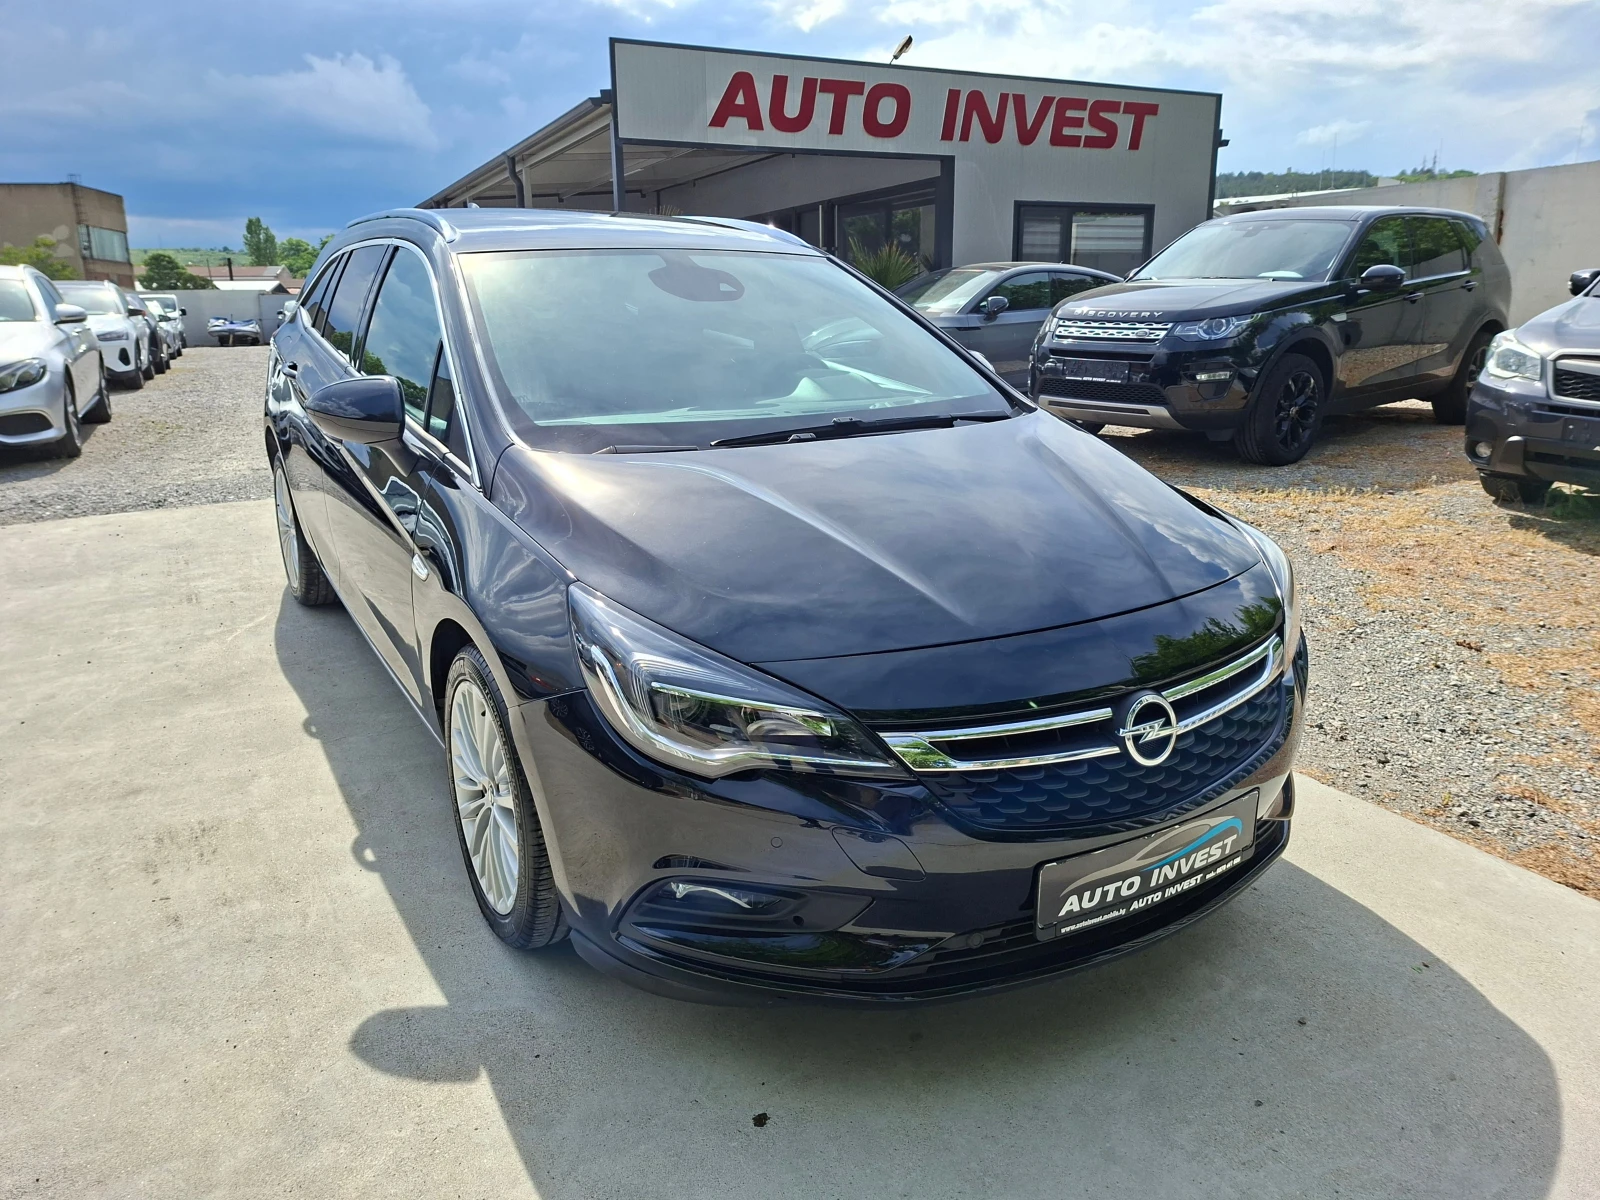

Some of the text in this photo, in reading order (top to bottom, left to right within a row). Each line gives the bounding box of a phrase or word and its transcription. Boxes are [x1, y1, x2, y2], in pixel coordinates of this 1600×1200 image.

[708, 71, 1160, 151] AUTO INVEST
[1073, 308, 1163, 318] DISCOVERY
[1058, 875, 1141, 917] AUTO
[1150, 834, 1238, 887] INVEST
[1129, 891, 1161, 911] AUTO
[1164, 873, 1203, 898] INVEST
